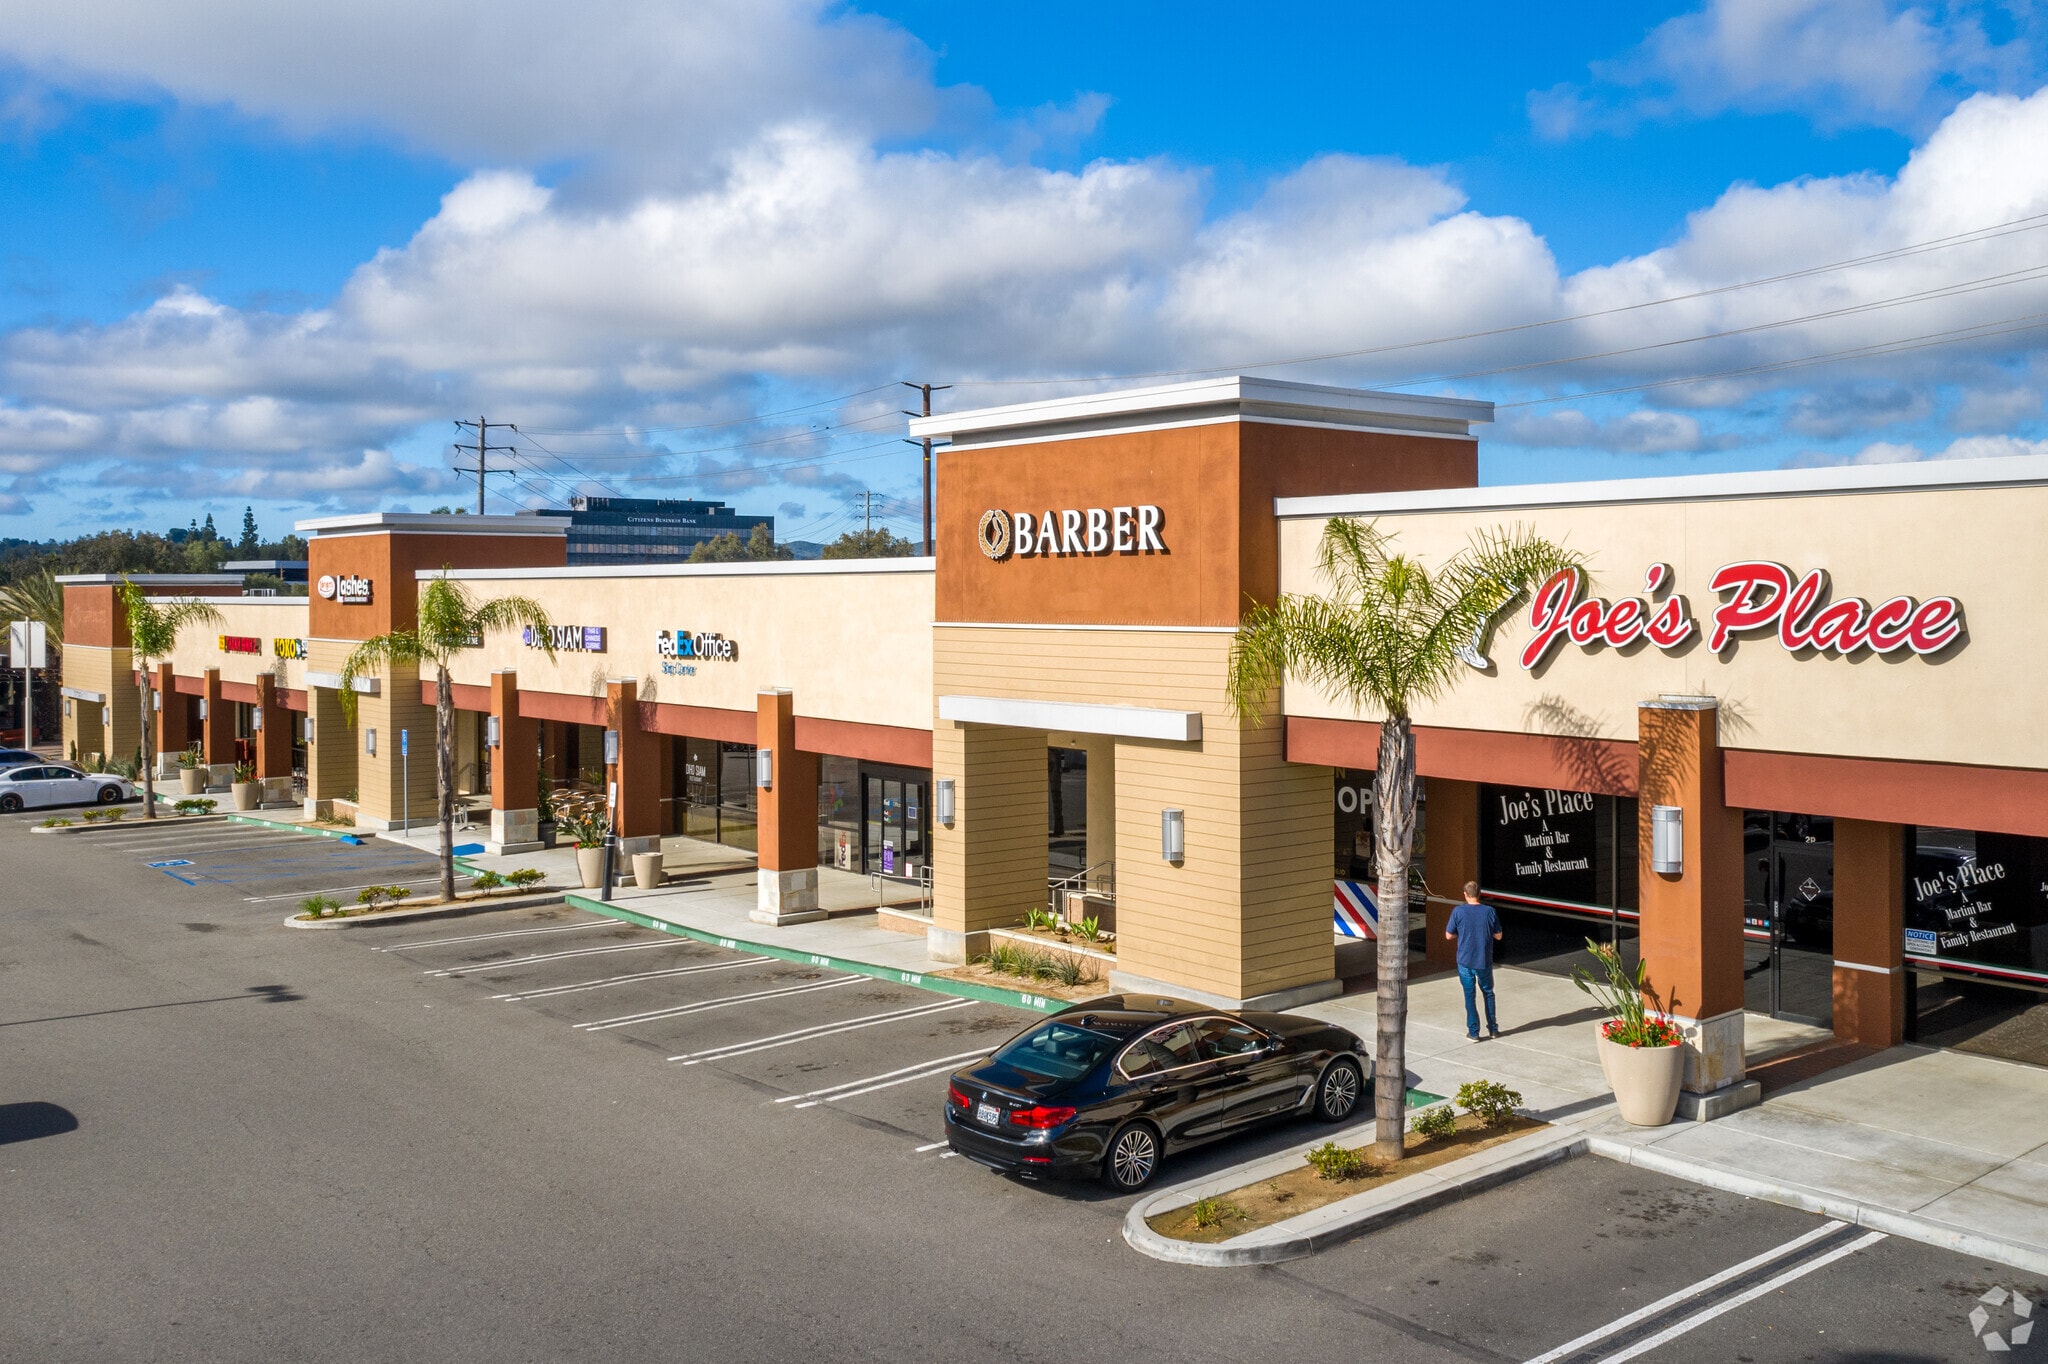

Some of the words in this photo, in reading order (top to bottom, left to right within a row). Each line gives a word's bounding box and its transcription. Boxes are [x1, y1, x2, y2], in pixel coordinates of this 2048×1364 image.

[1014, 505, 1164, 554] BARBER
[1518, 562, 1692, 671] Joe's
[1707, 559, 1960, 655] Place
[557, 625, 583, 649] SIAM
[656, 629, 693, 656] FedEx
[694, 632, 731, 657] Office
[1338, 786, 1374, 815] OP
[1500, 792, 1541, 825] Joe's
[1544, 789, 1594, 816] Place
[1542, 819, 1549, 832] A
[1524, 832, 1554, 848] Martini
[1555, 831, 1570, 844] Bar
[1545, 846, 1553, 859] &
[1515, 861, 1543, 877] Family
[1544, 857, 1589, 873] Restaurant
[1913, 871, 1957, 902] Joe's
[1958, 862, 2006, 888] Place
[1961, 891, 1969, 903] A
[1945, 904, 1976, 921] Martini
[1976, 901, 1992, 913] Bar
[1969, 916, 1978, 928] &
[1908, 930, 1934, 940] NOTICE
[1940, 933, 1969, 949] Family
[1969, 923, 2017, 942] Restaurant
[901, 972, 910, 982] 60
[911, 974, 921, 985] MIN
[1021, 994, 1032, 1005] 60
[1034, 996, 1046, 1008] MIN
